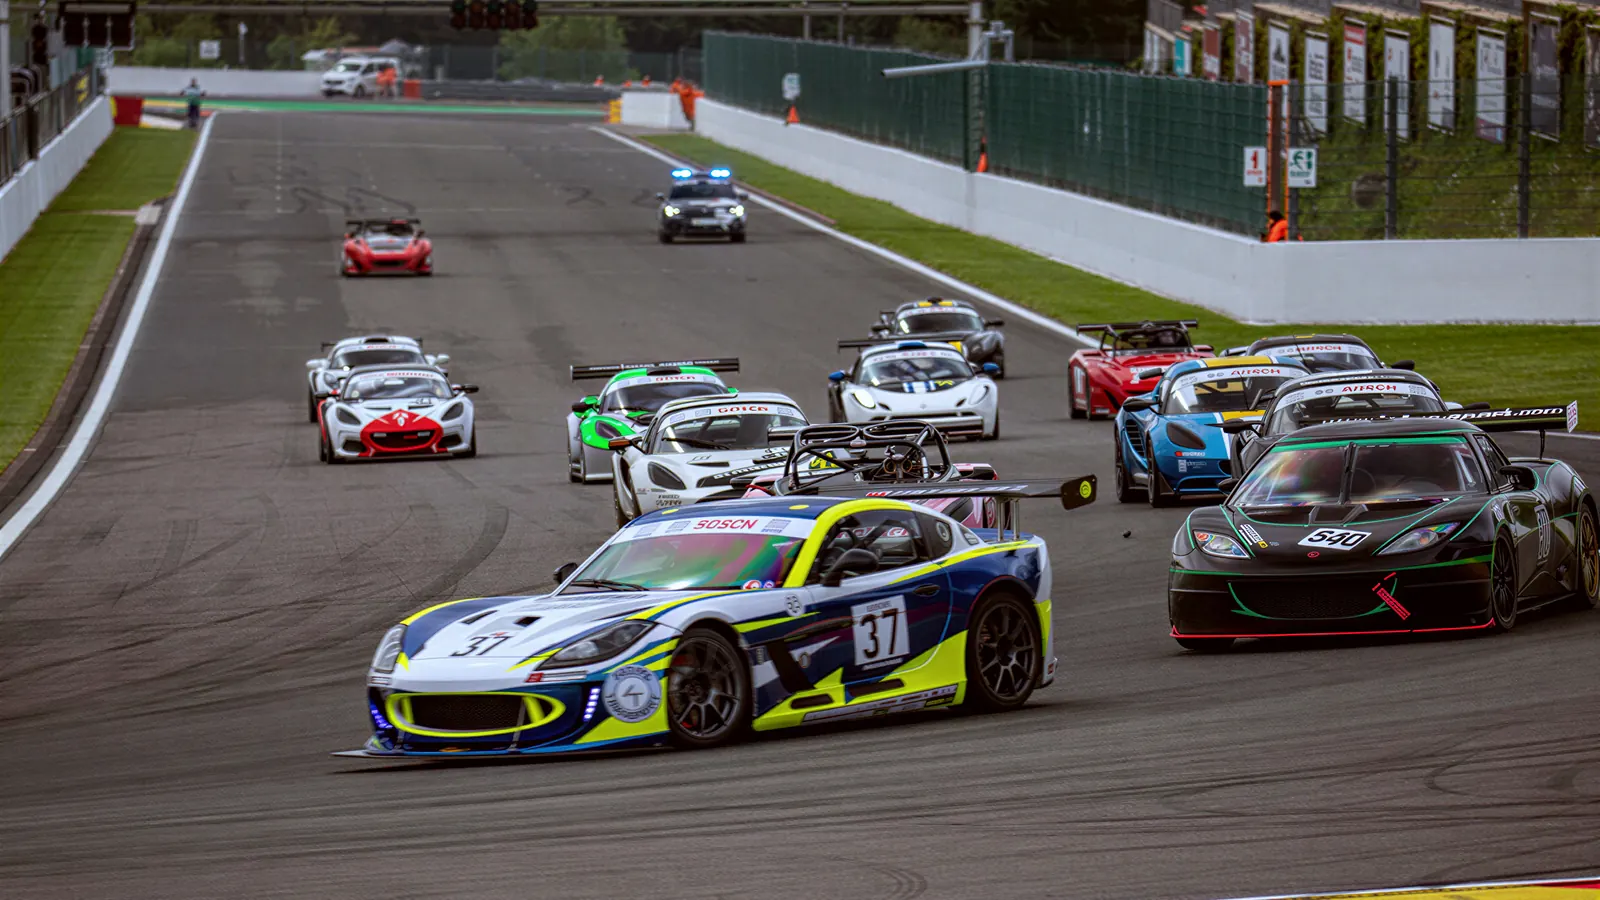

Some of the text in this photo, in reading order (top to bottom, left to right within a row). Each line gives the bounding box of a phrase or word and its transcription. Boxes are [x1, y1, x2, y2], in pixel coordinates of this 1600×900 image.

[1307, 530, 1361, 547] 540
[859, 608, 899, 659] 37
[451, 636, 512, 657] 37
